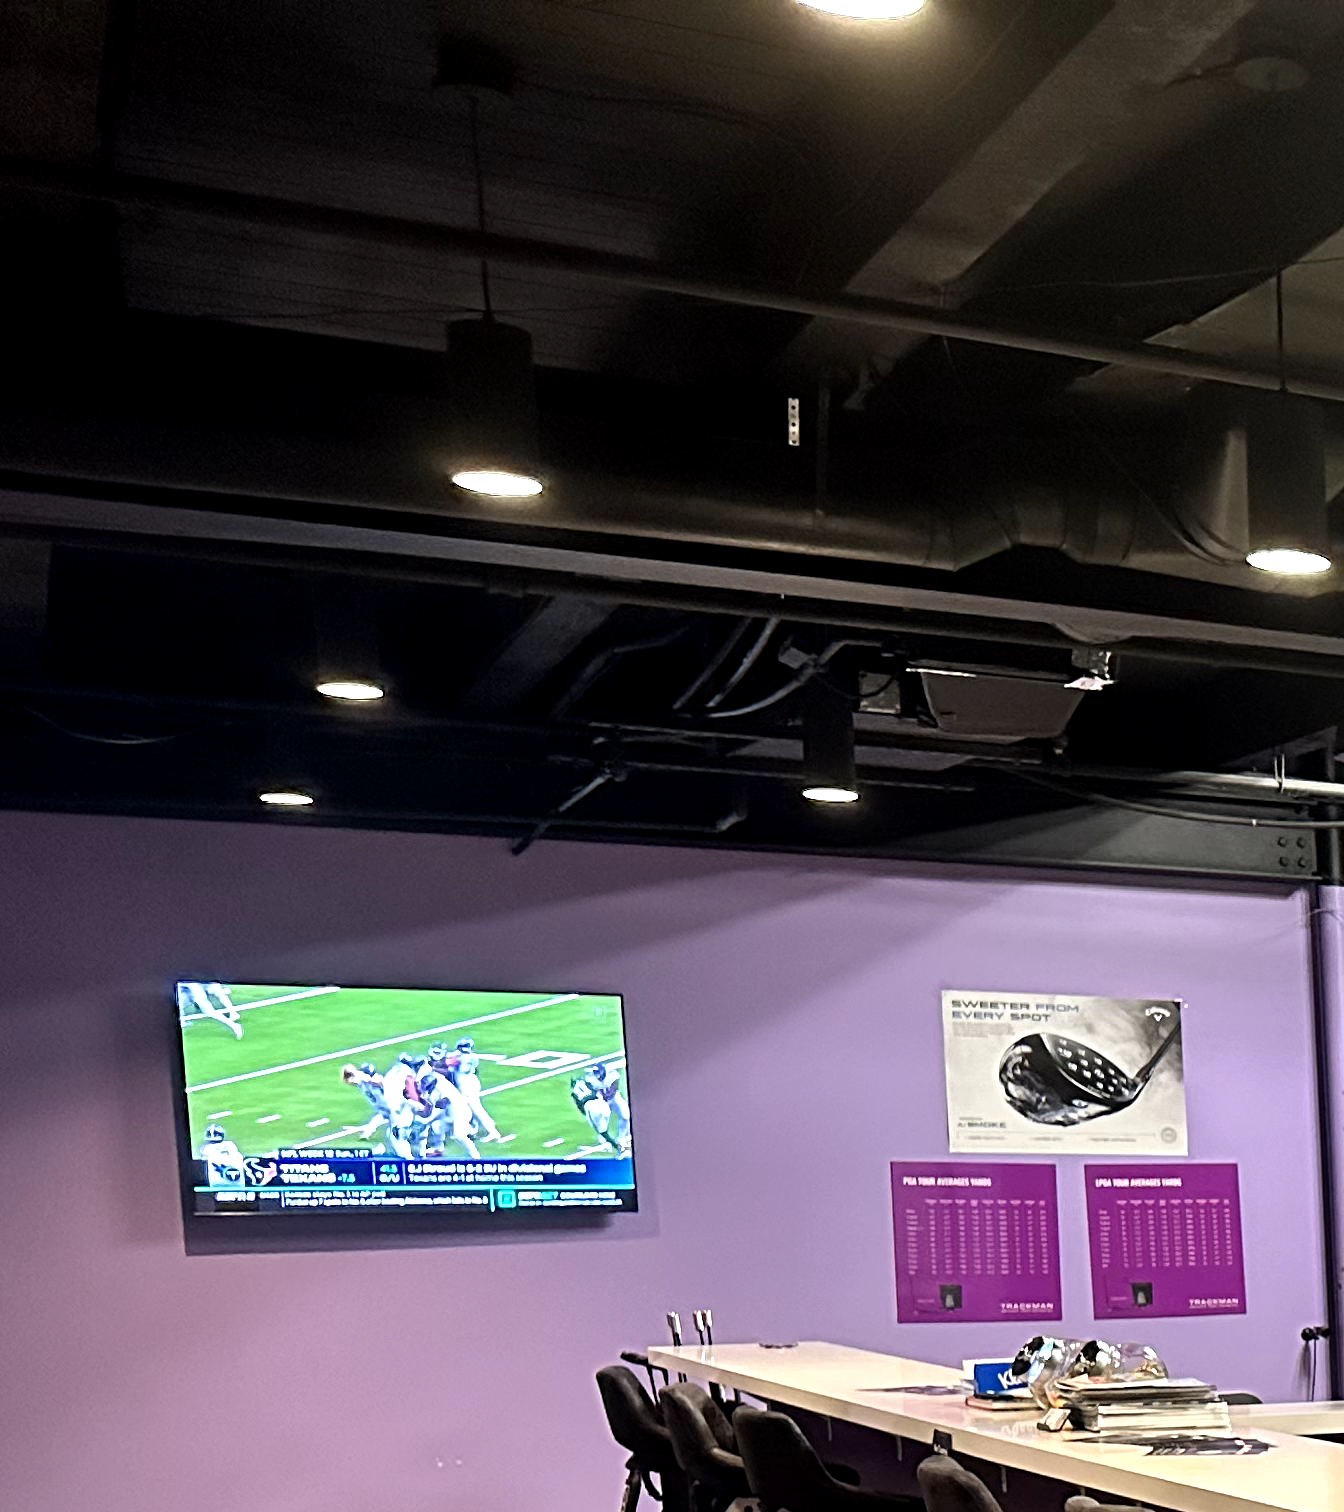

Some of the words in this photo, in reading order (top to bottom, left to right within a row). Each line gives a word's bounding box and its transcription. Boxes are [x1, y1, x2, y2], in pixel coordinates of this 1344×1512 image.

[952, 1000, 1030, 1011] SWEETER
[1035, 1003, 1080, 1013] FROM
[952, 1010, 1005, 1021] EVERY
[1010, 1012, 1051, 1022] SPOT
[279, 1163, 330, 1174] TITANS
[280, 1173, 337, 1184] TEXANS
[936, 1177, 970, 1187] AVERAGES
[1130, 1178, 1161, 1187] AVERAGES
